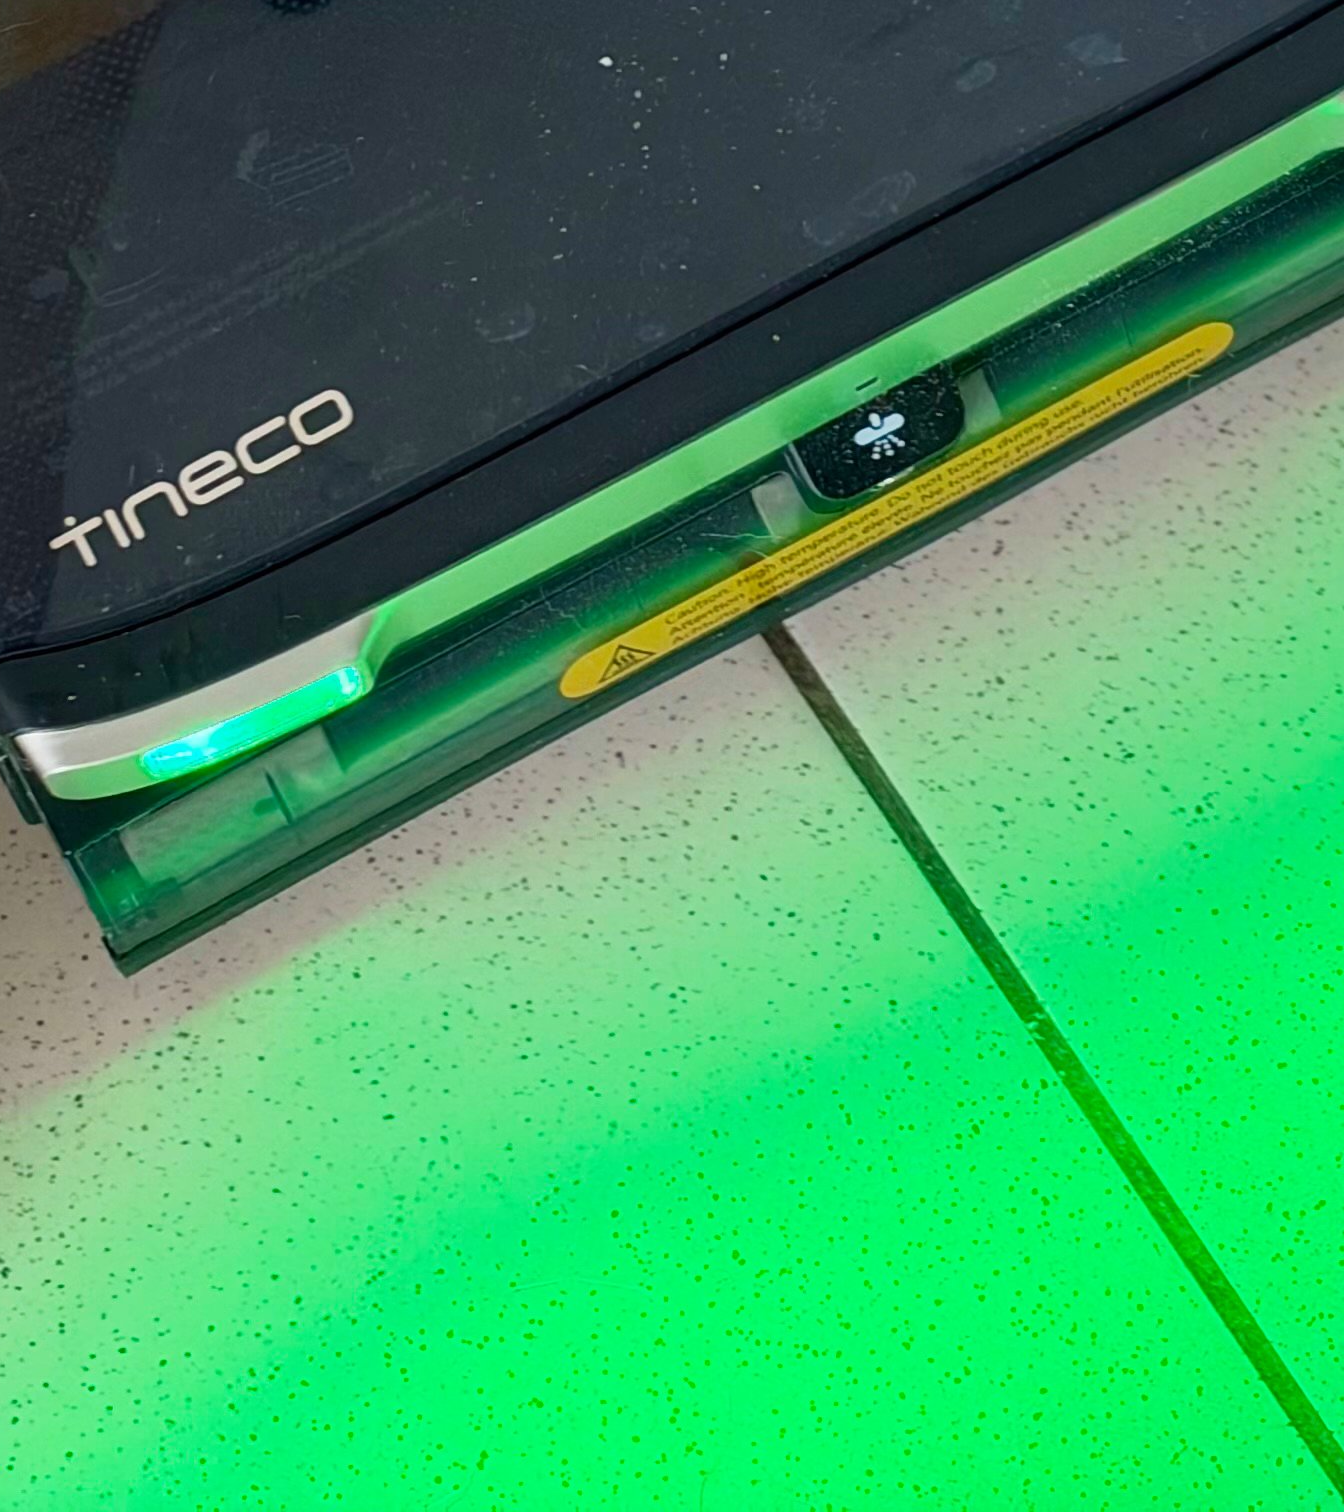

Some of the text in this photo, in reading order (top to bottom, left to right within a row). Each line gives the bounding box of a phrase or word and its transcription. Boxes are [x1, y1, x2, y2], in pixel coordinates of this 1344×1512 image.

[736, 561, 776, 588] High
[886, 489, 910, 507] Do
[915, 473, 942, 492] not
[947, 445, 992, 475] touch
[995, 415, 1050, 450] during
